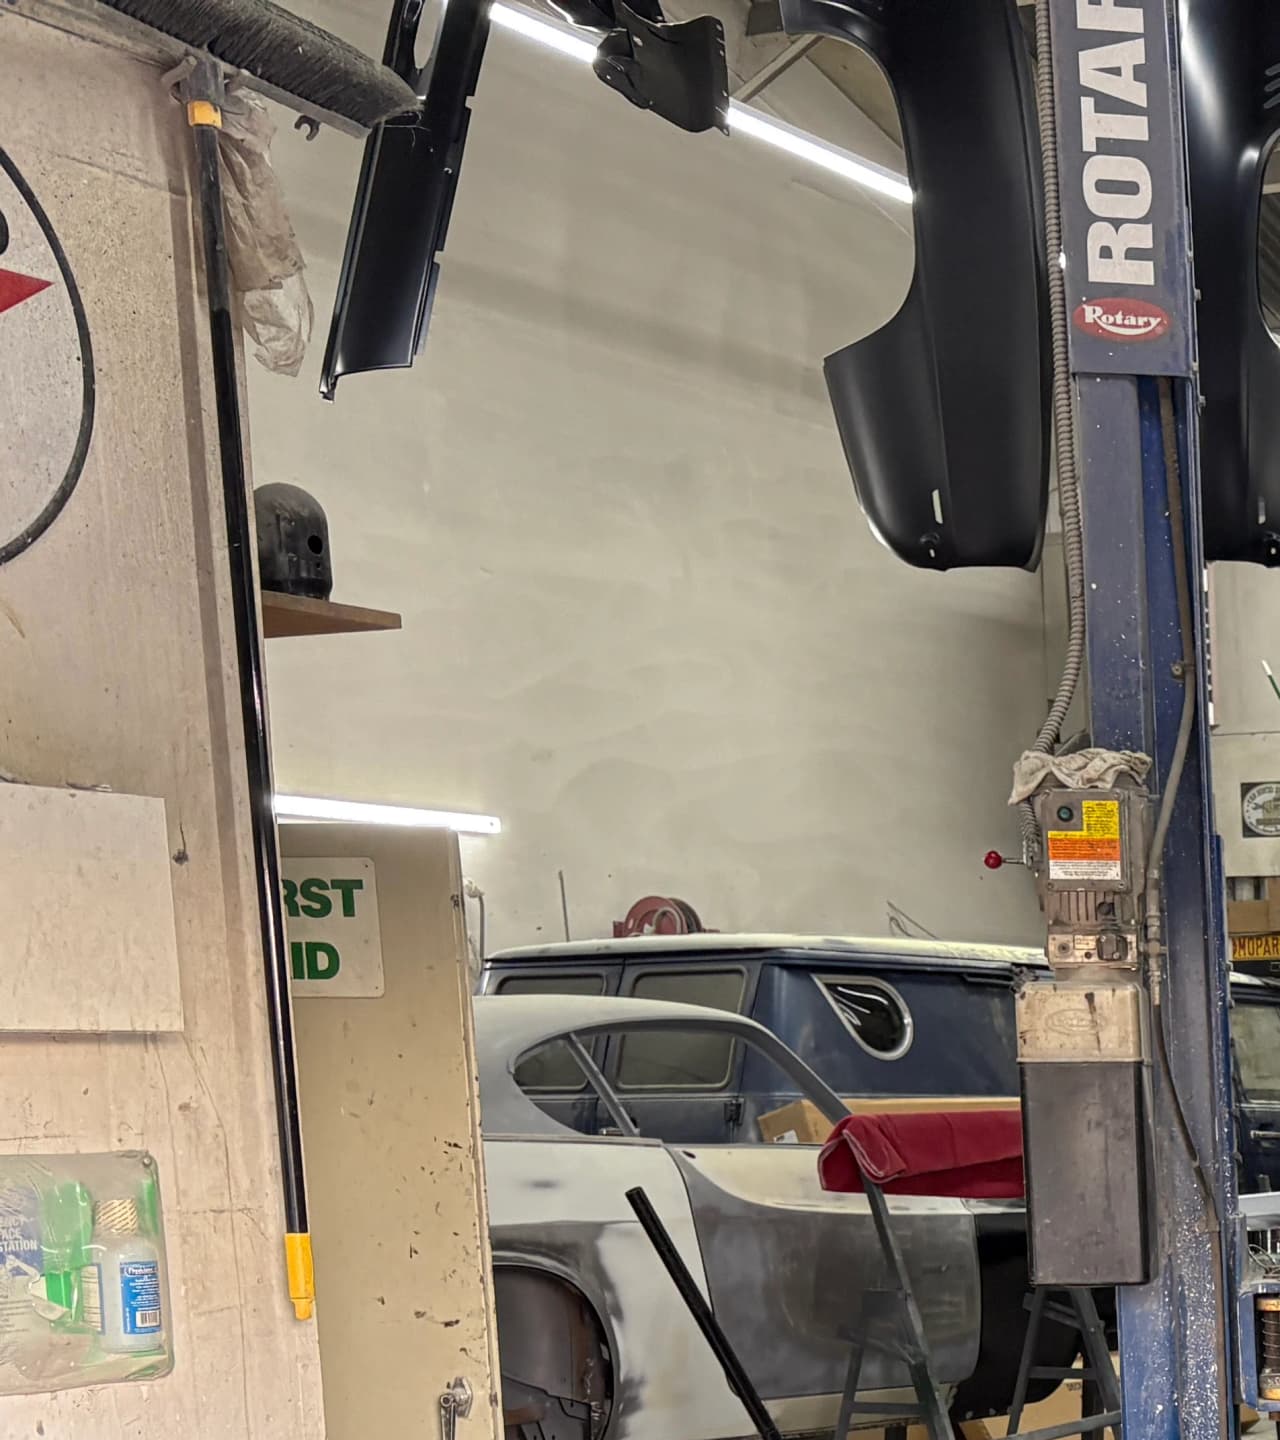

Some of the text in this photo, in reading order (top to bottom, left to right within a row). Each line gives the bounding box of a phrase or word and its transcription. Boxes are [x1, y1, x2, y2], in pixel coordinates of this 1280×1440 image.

[1082, 304, 1162, 336] Rotary
[281, 878, 364, 918] RST
[290, 941, 340, 980] ID
